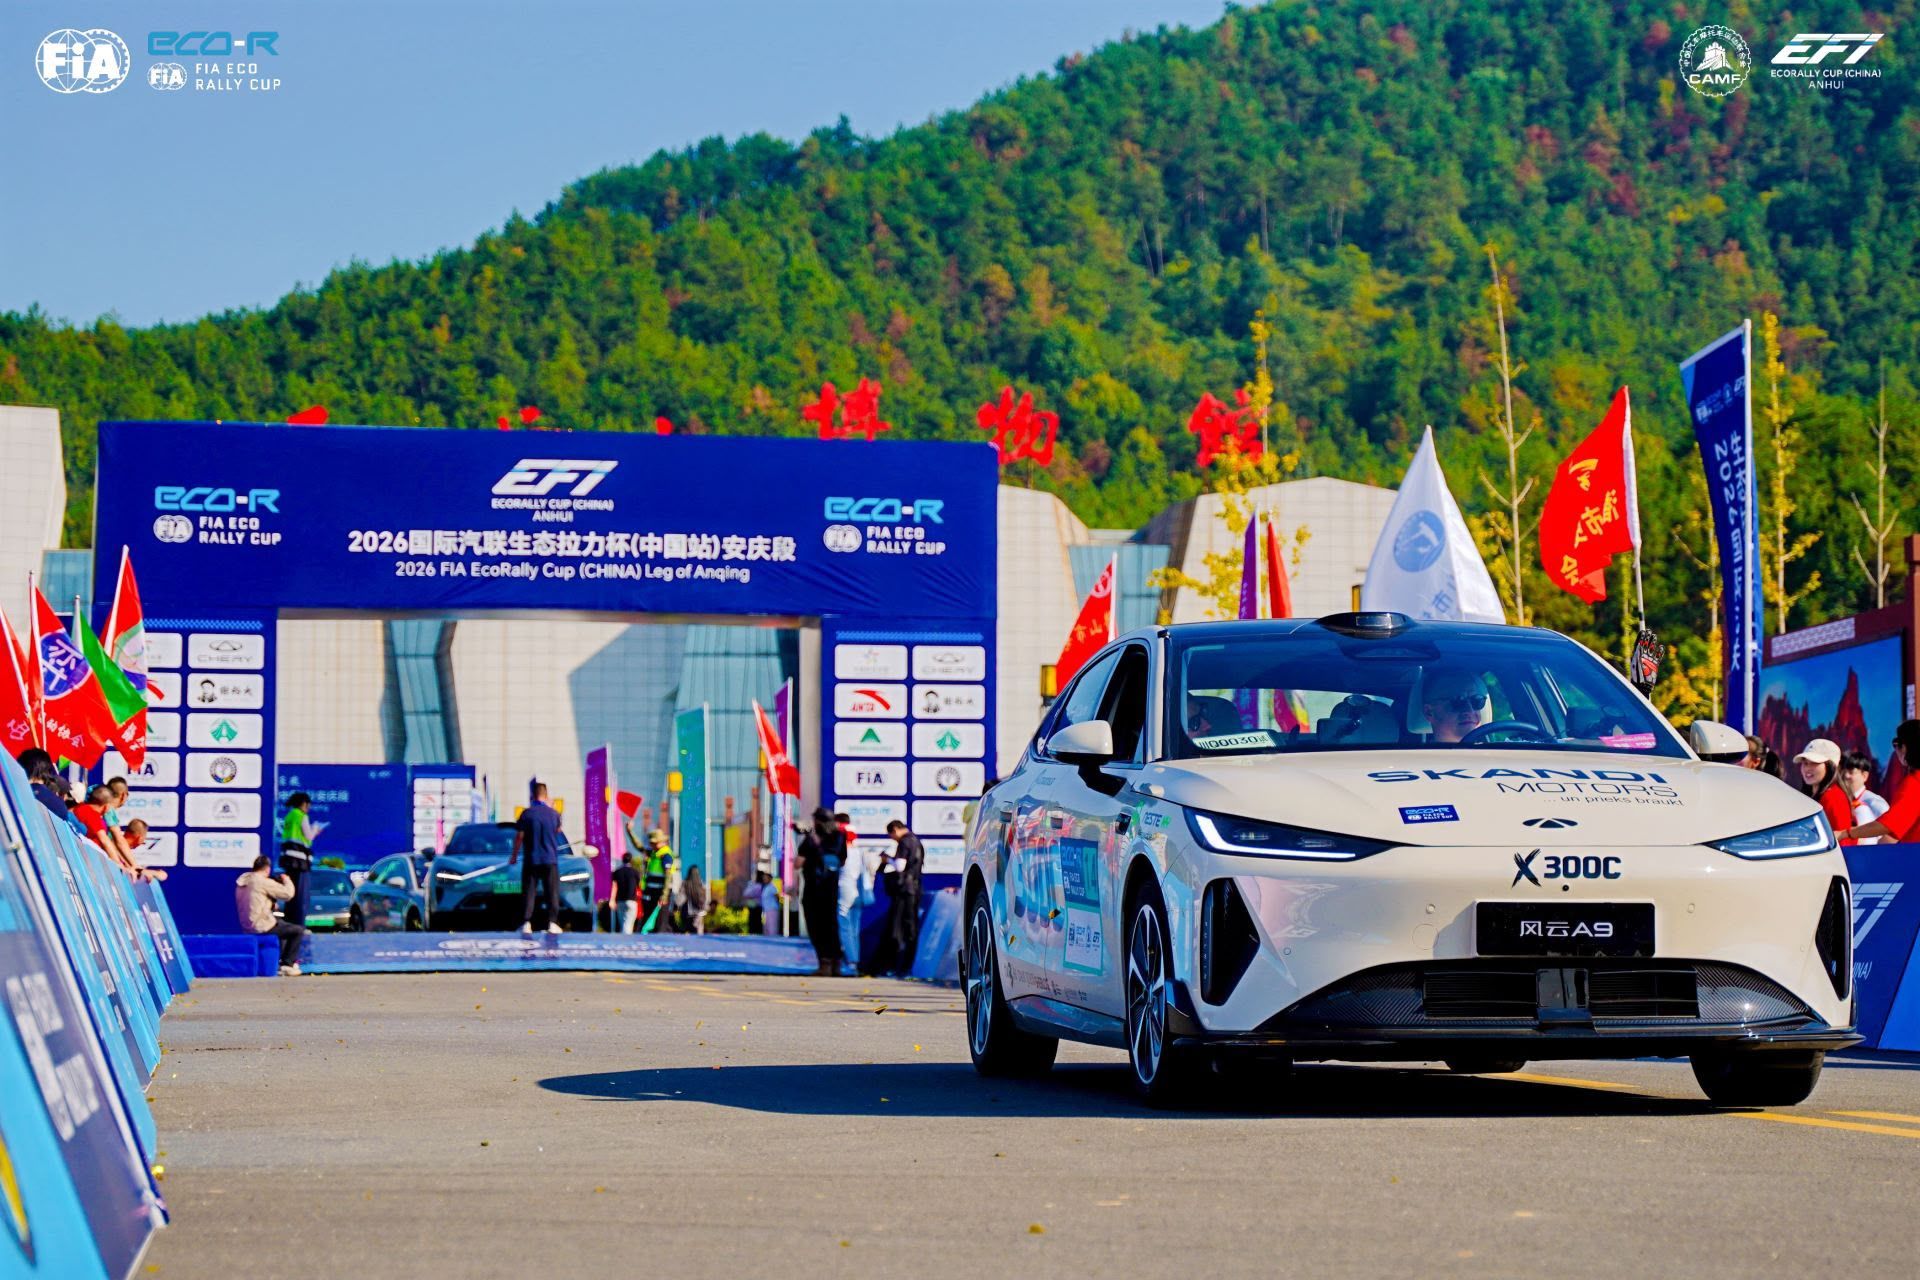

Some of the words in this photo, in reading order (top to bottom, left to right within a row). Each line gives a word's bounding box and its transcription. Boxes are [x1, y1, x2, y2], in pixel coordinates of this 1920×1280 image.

[491, 498, 548, 510] ECORALLY
[548, 499, 572, 510] CUP
[573, 499, 615, 512] (CHINA)
[199, 516, 225, 530] FIA
[228, 516, 260, 531] ECO
[532, 510, 574, 522] ANHUI
[198, 531, 245, 545] RALLY
[250, 532, 282, 546] CUP
[866, 525, 892, 540] FIA
[894, 526, 925, 541] ECO
[866, 540, 911, 554] RALLY
[915, 541, 946, 556] CUP
[395, 560, 437, 577] 2026
[440, 562, 466, 577] FIA
[470, 562, 539, 581] EcoRally
[542, 563, 576, 581] Cup
[579, 562, 642, 580] (CHINA)
[645, 564, 674, 582] Leg
[675, 564, 693, 579] of
[694, 564, 751, 584] Anqing
[1367, 768, 1667, 783] SKANDI
[1496, 782, 1678, 798] MOTORS
[1585, 796, 1631, 804] prieks
[1635, 796, 1685, 807] braukt
[1543, 856, 1622, 880] 300C
[1520, 921, 1613, 937] 风云A9
